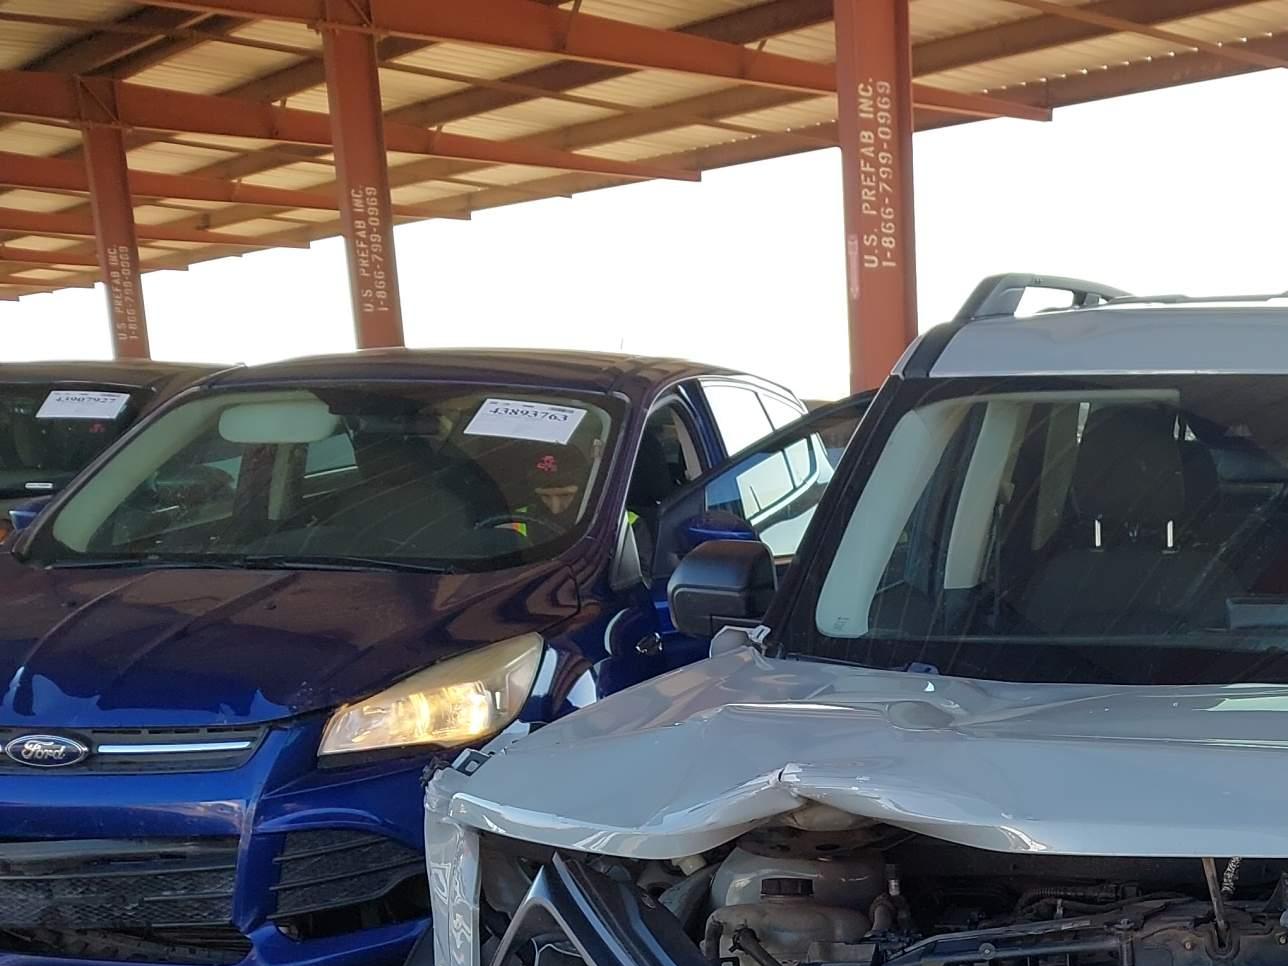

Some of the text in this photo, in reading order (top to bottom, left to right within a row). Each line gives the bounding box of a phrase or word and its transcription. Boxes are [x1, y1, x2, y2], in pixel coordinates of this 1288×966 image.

[857, 77, 875, 119] INC.
[859, 130, 878, 216] PREFAB
[876, 80, 897, 268] 1-866-799-0969
[354, 219, 371, 278] PREFAB
[21, 740, 67, 760] Ford
